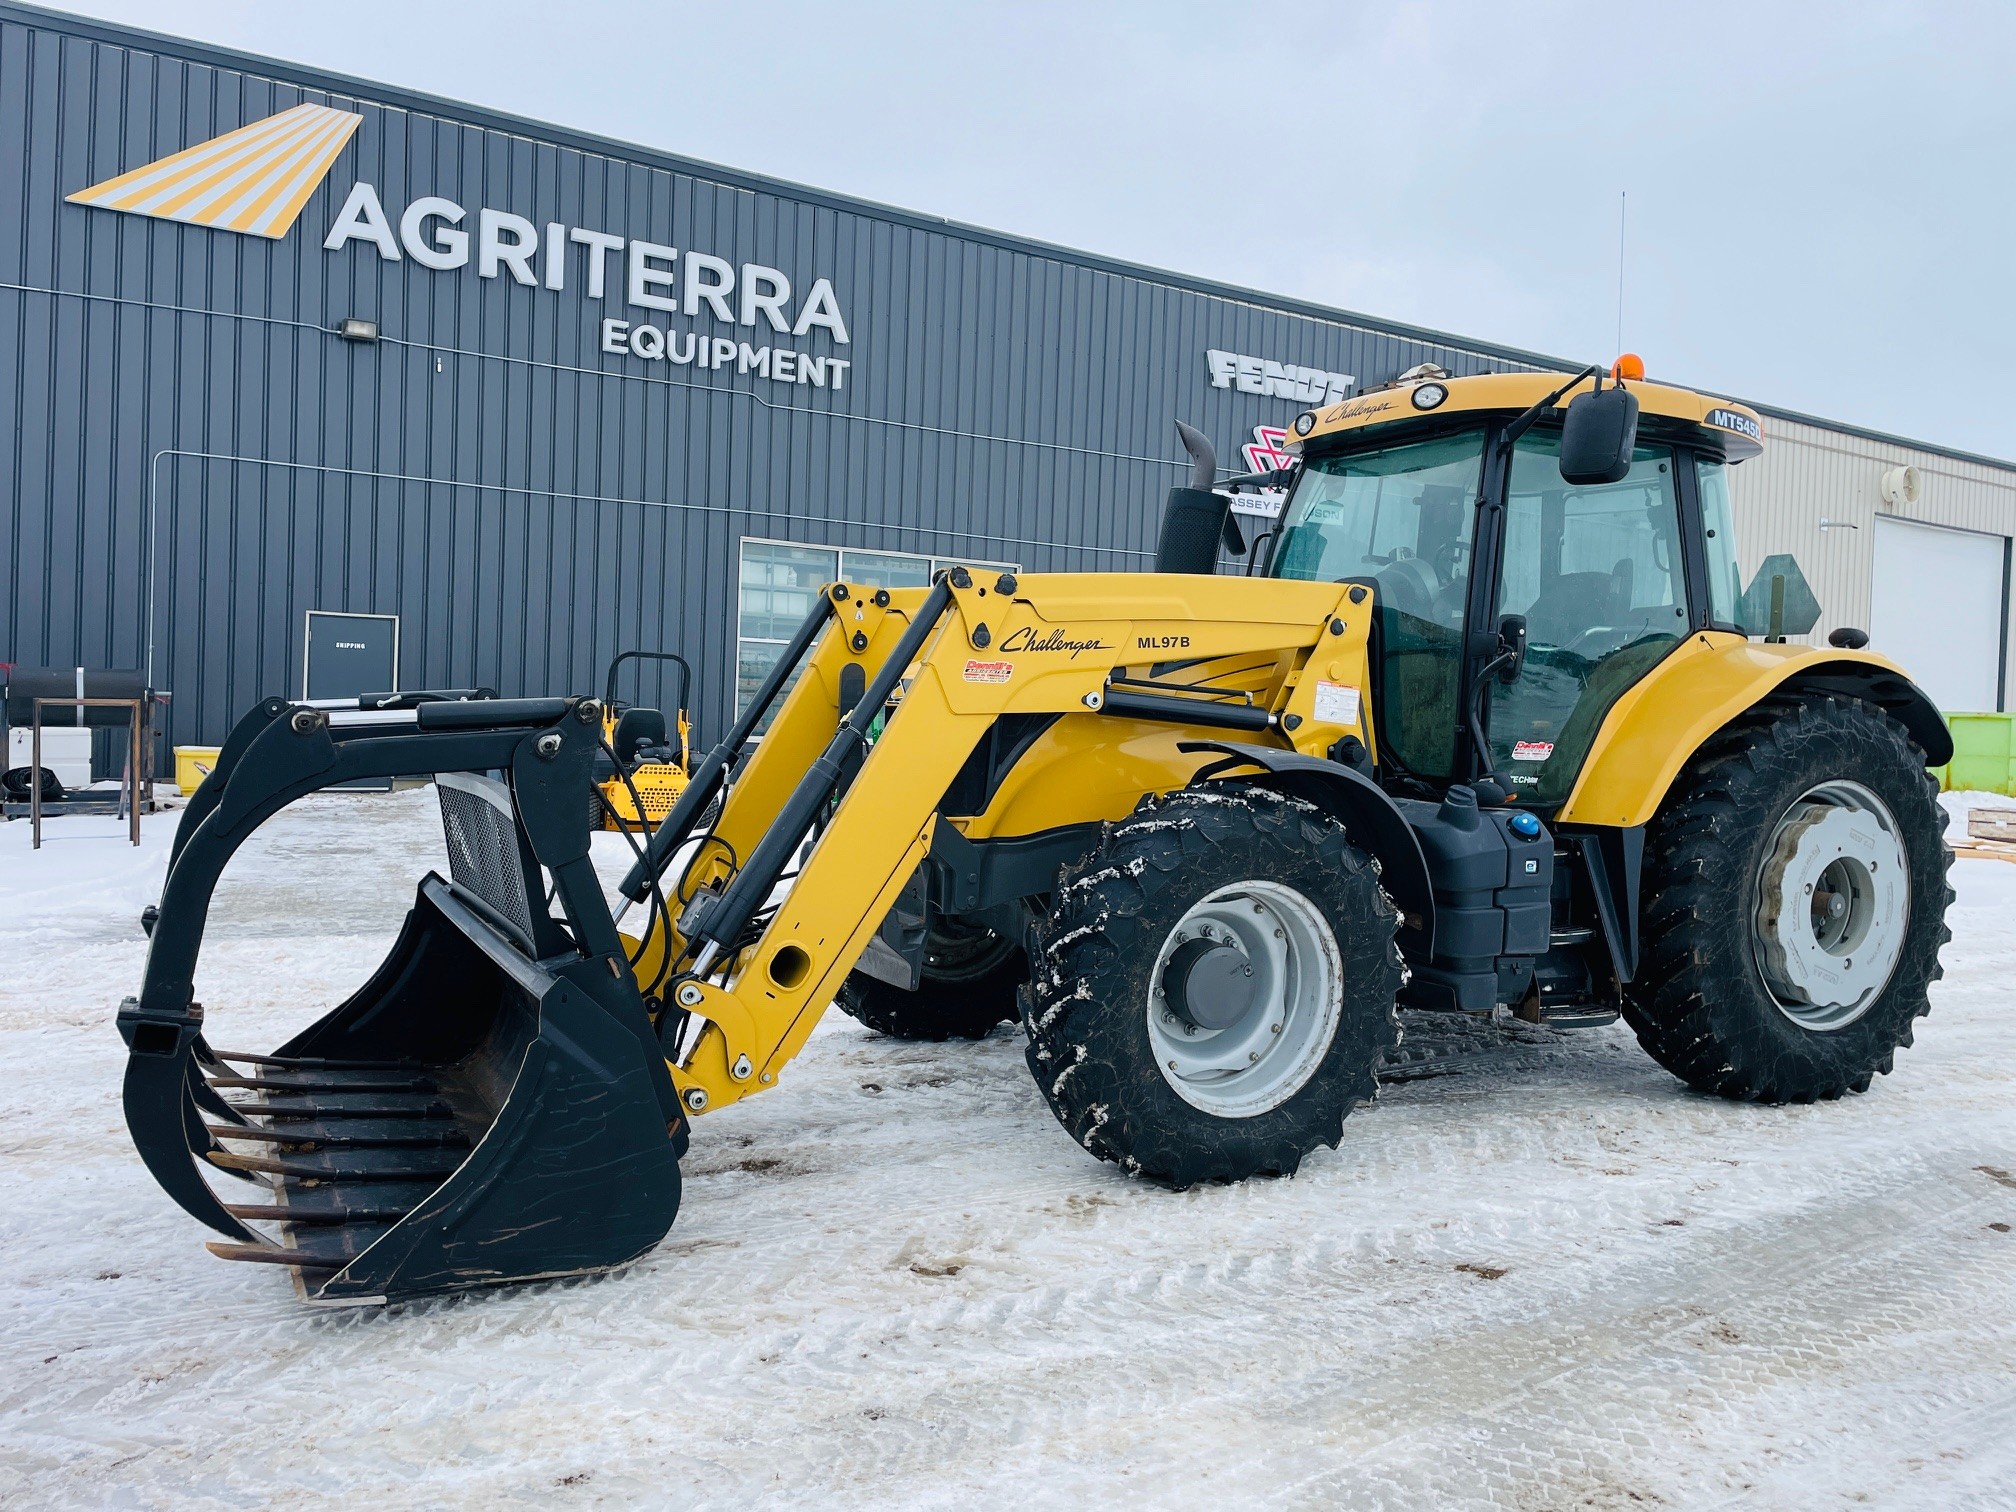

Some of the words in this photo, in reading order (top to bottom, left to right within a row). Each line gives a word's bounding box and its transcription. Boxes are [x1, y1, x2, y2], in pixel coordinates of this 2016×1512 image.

[323, 181, 850, 344] AGRITERRA
[602, 317, 851, 390] EQUIPMENT
[1206, 349, 1356, 405] FENDT
[1325, 399, 1399, 423] Challenger
[1714, 409, 1760, 439] MT545D
[1231, 497, 1271, 511] ASSEY
[335, 642, 366, 650] SHIPPING
[999, 626, 1116, 660] Challenger
[1137, 636, 1191, 649] ML97B
